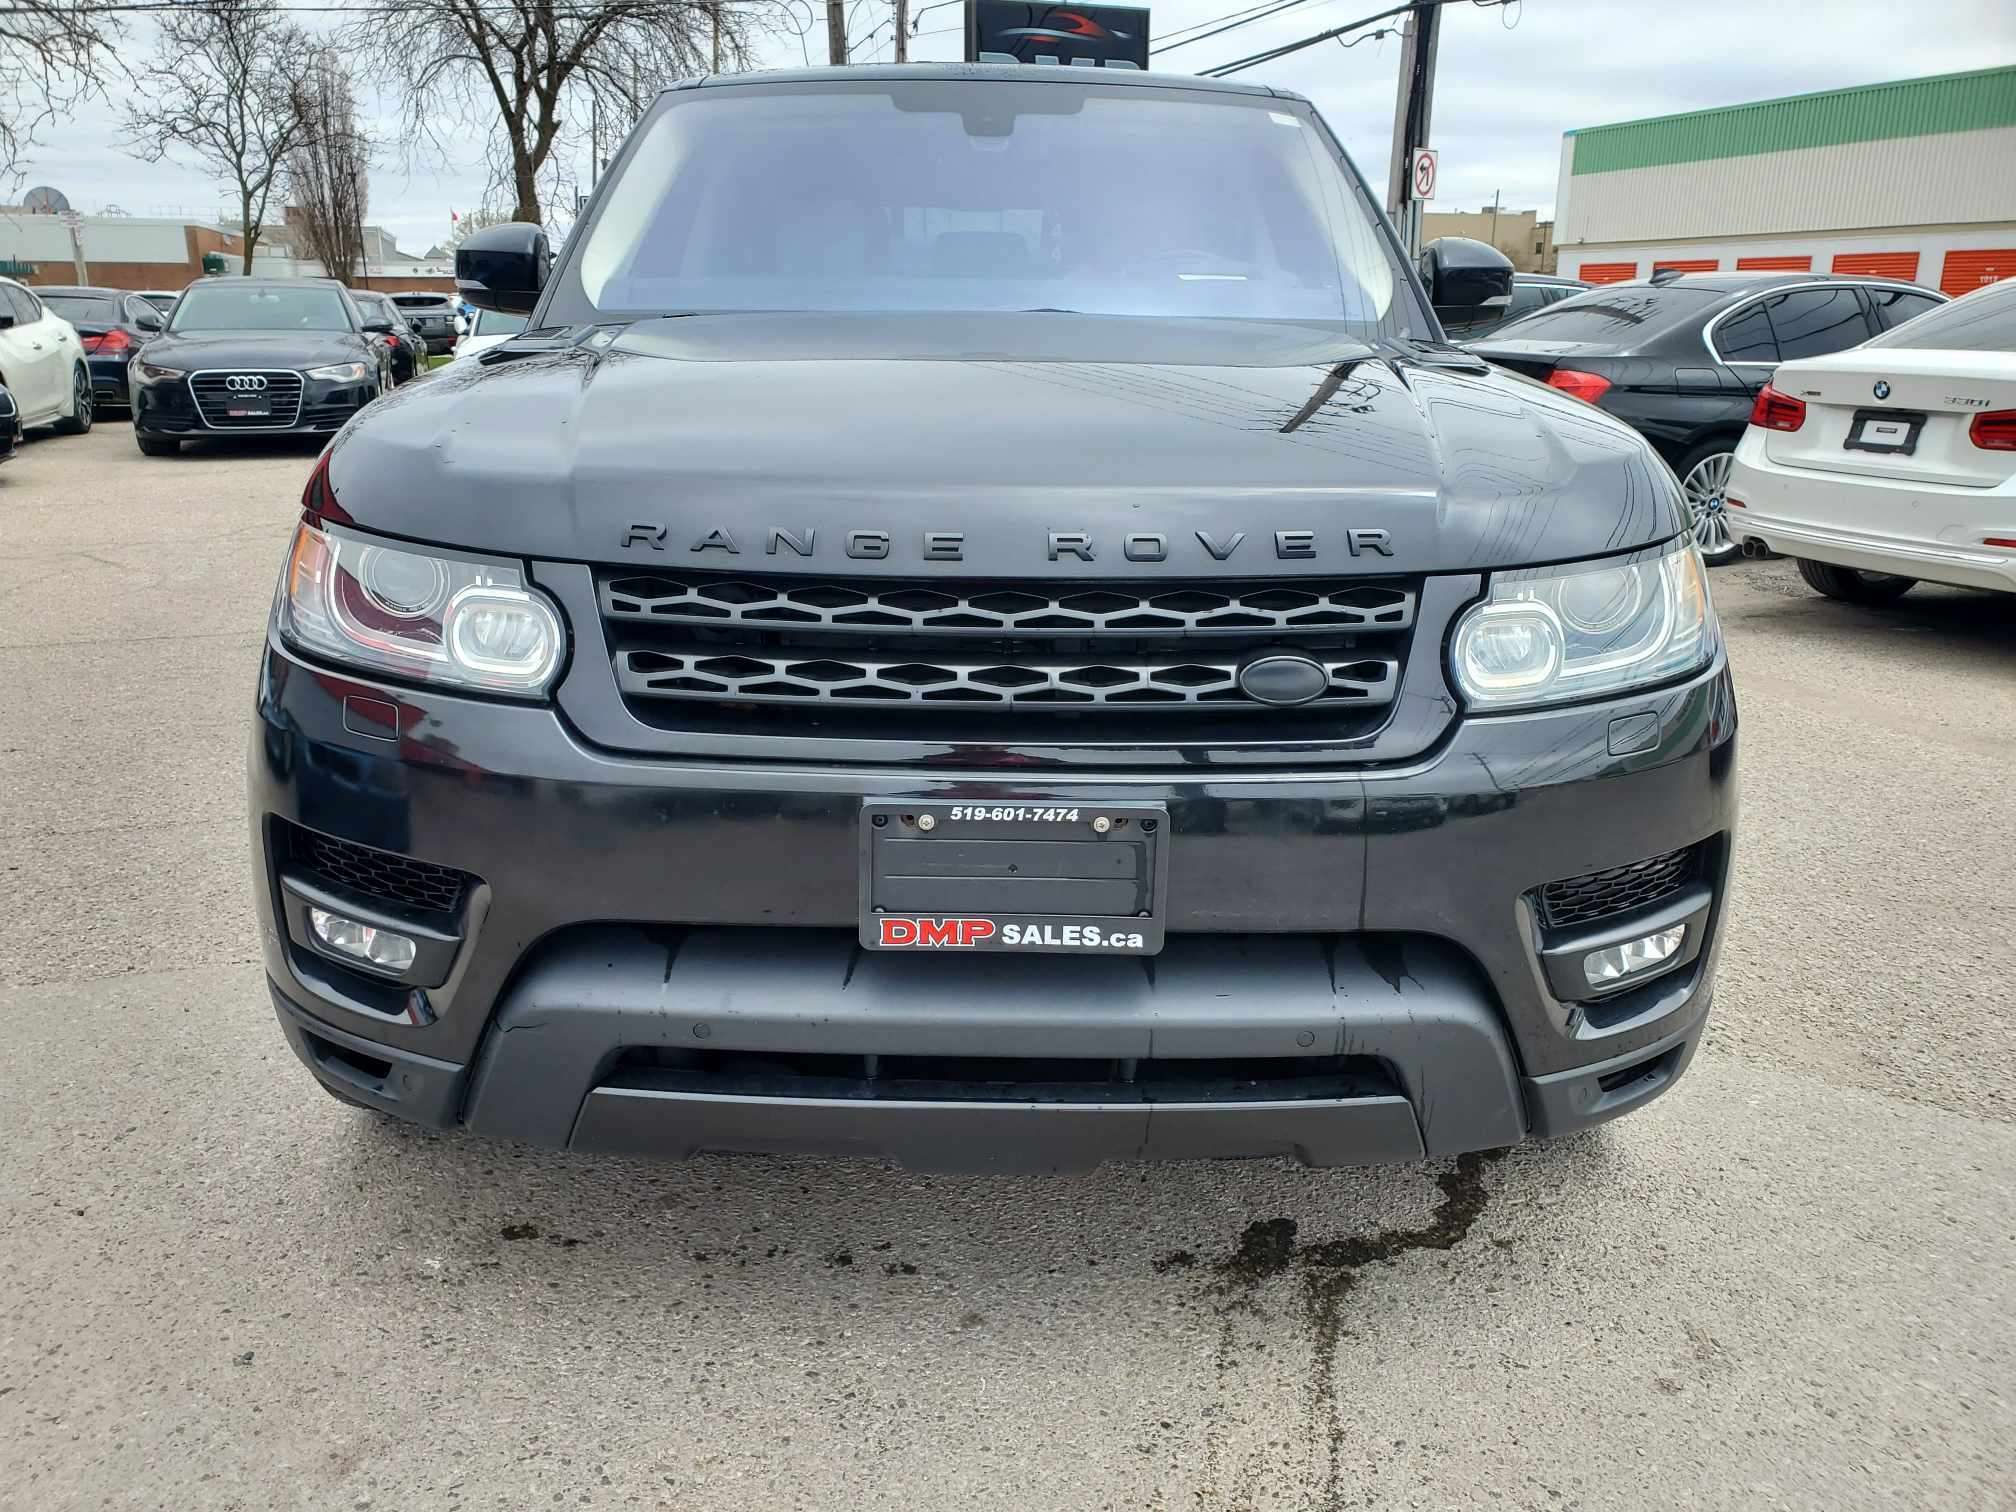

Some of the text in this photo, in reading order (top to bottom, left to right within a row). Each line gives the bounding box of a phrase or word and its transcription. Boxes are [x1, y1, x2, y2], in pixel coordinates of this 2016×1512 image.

[620, 521, 1394, 562] RANGE ROVER
[950, 806, 1079, 822] 519-601-7474
[879, 918, 1144, 948] DMP SALES.ca
